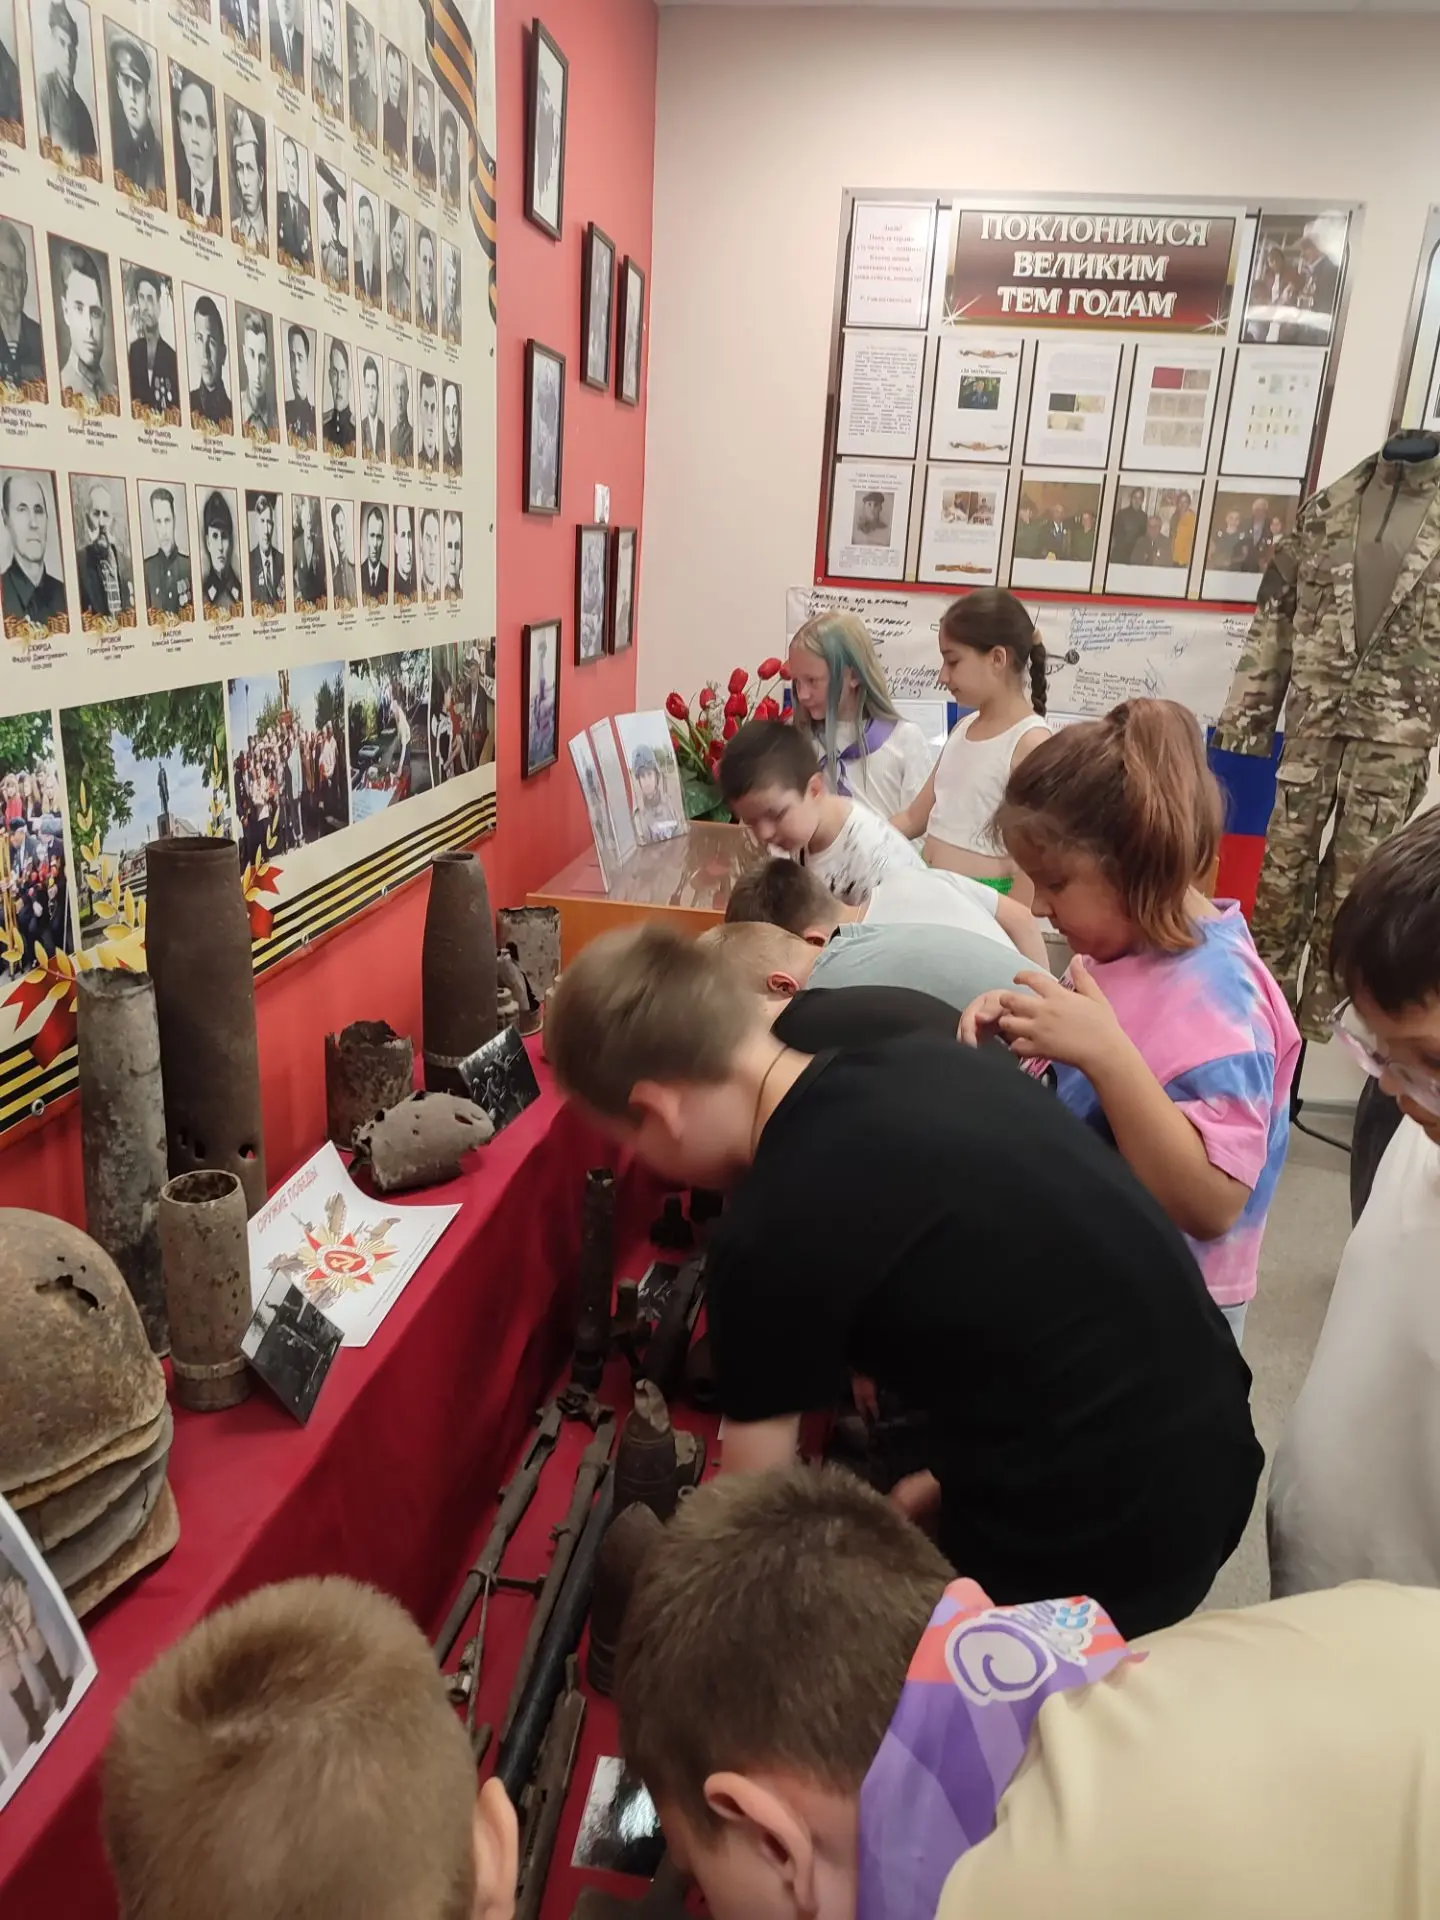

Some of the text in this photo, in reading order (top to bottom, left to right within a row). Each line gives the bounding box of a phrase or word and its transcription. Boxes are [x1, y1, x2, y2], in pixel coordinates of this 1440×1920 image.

[980, 213, 1212, 247] ПОКЛОНИМСЯ
[1012, 251, 1169, 282] ВЕЛИКИМ
[997, 286, 1177, 319] ТЕМ ГОДАМ
